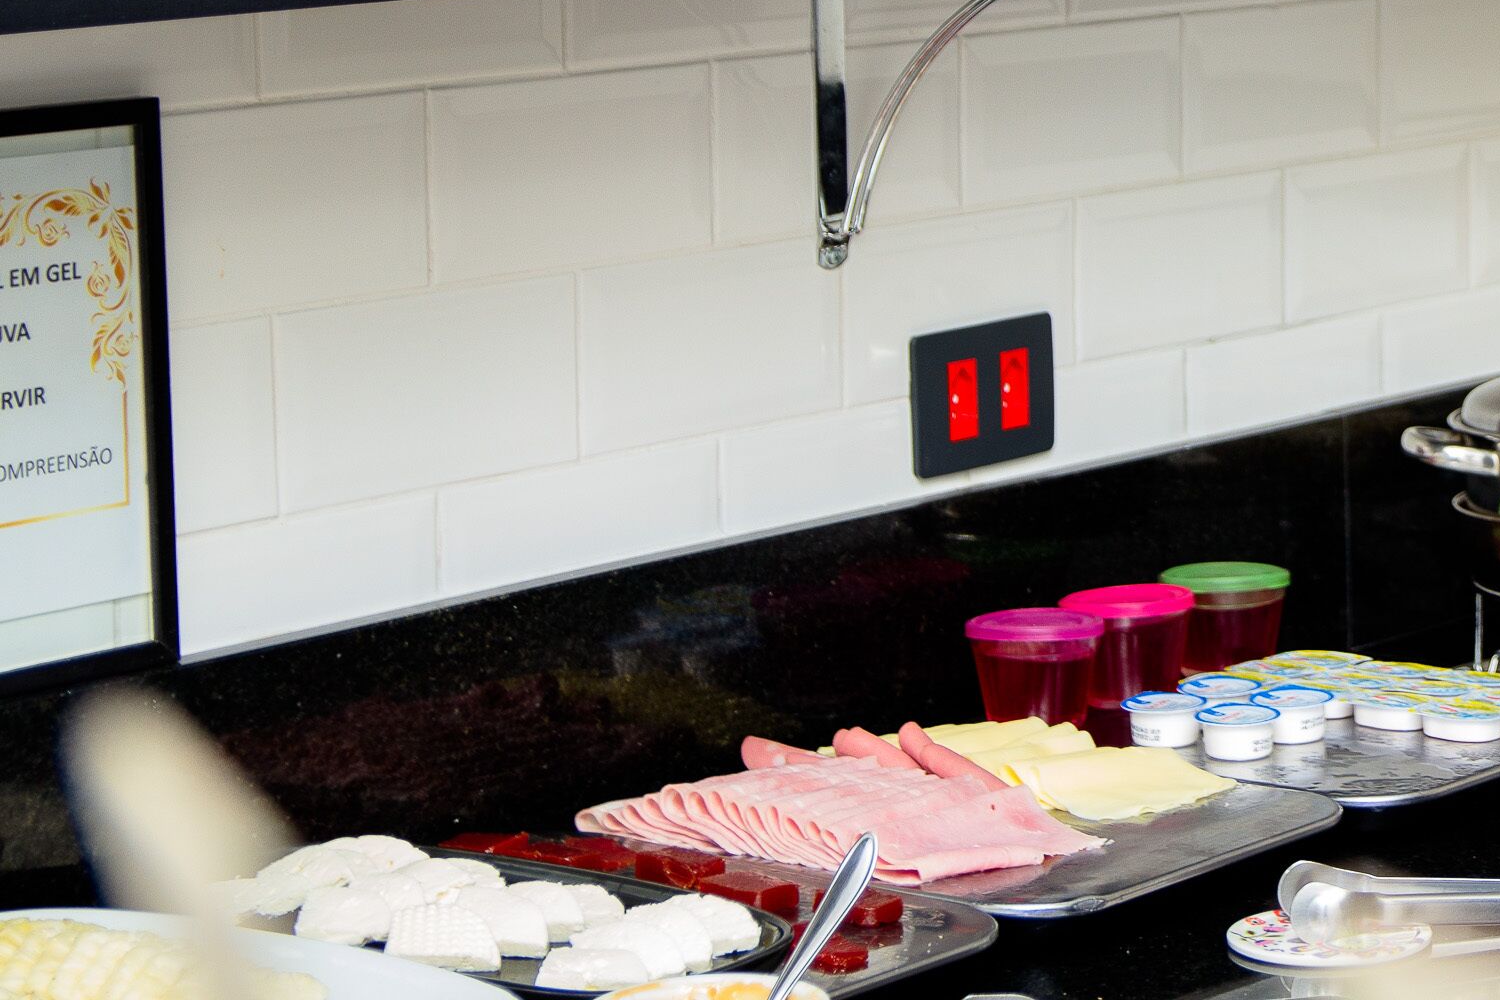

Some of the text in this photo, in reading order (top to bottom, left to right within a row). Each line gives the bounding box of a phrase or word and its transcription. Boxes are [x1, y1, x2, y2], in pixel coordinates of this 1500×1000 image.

[9, 262, 82, 288] EM GEL
[0, 322, 31, 343] VA
[1, 386, 46, 410] RVIR
